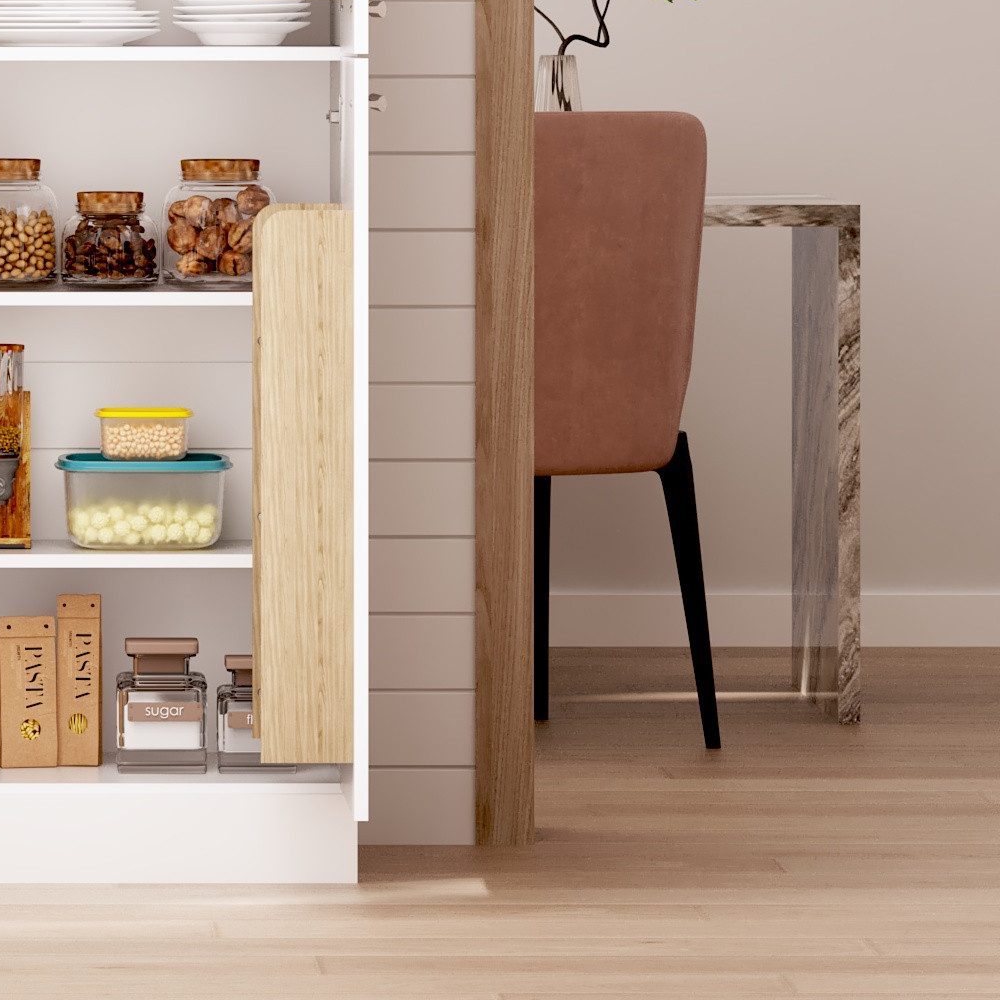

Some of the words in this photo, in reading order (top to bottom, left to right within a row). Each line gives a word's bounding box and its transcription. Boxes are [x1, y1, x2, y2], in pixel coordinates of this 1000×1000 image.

[24, 646, 43, 709] PASTA
[75, 633, 92, 699] PASTA
[145, 705, 185, 719] sugar
